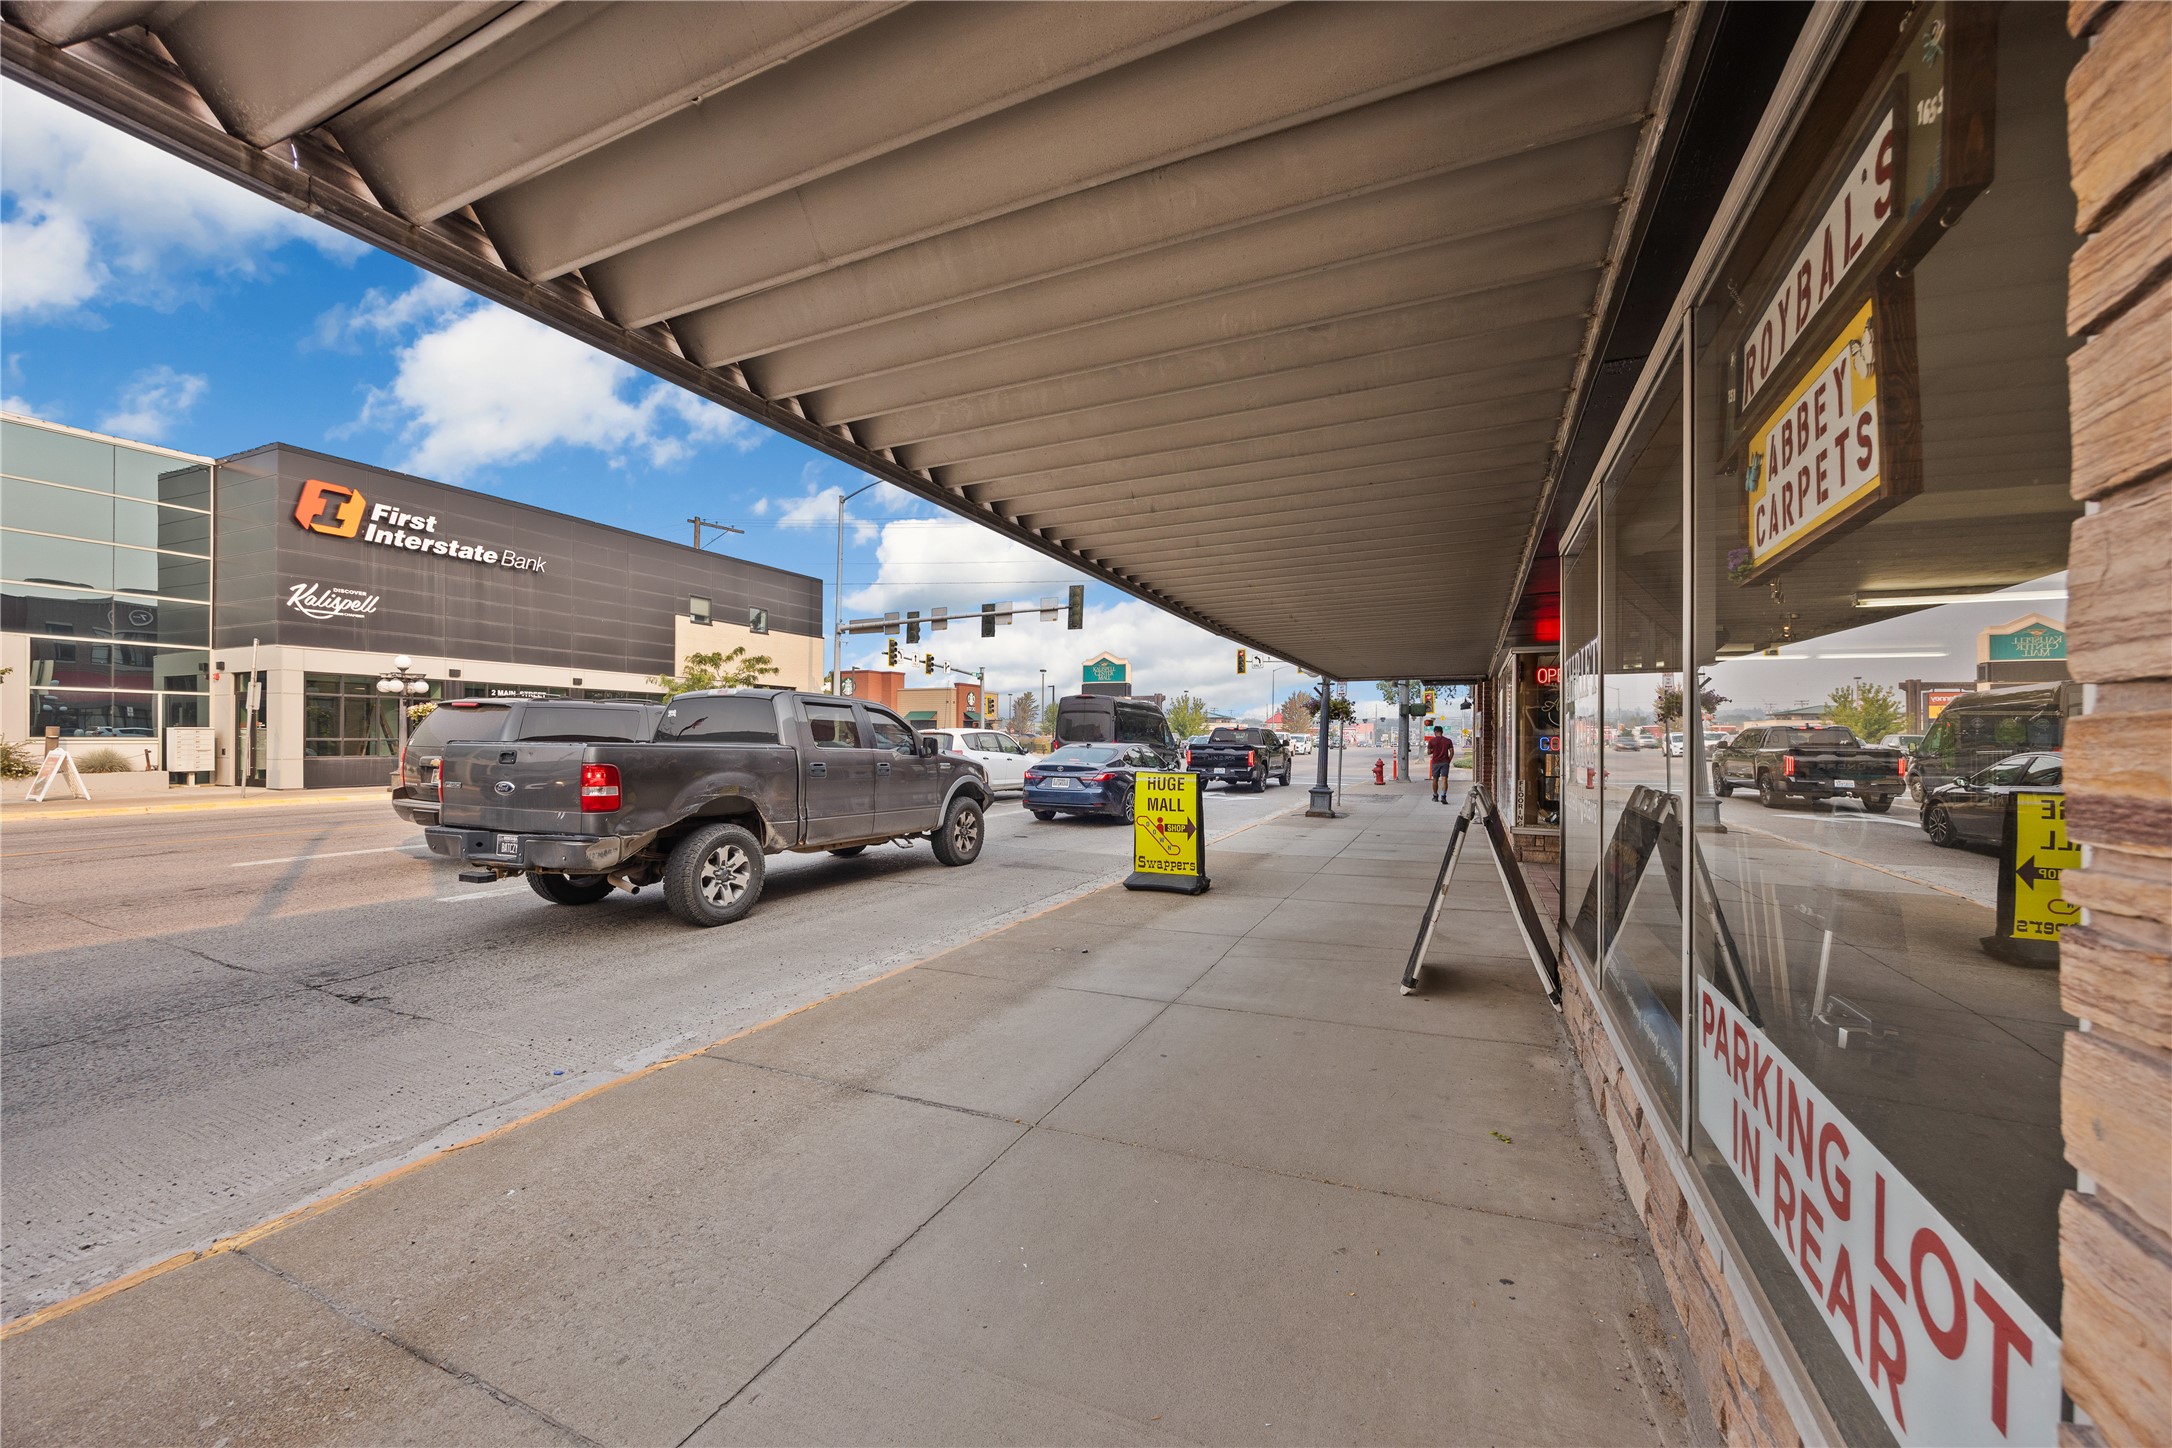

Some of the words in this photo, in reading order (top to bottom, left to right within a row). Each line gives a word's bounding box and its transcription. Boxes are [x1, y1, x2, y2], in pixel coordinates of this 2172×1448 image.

[1744, 128, 1893, 407] ROYBAL'S
[1767, 357, 1847, 482] ABBEY
[1755, 411, 1873, 549] CARPETS
[370, 503, 437, 533] First
[364, 523, 498, 564] Interstate
[500, 549, 547, 573] Bank
[286, 583, 380, 619] Kalispell
[332, 587, 367, 596] DISCOVER
[497, 689, 516, 697] MAIN
[520, 690, 547, 698] STREET
[1147, 776, 1185, 791] HUGE
[1147, 797, 1185, 812] MALL
[1167, 824, 1186, 832] SHOP
[1137, 855, 1196, 872] Swappers
[1702, 989, 1852, 1222] PARKING
[1874, 1171, 2033, 1439] LOT
[1733, 1097, 1760, 1198] IN
[1773, 1152, 1907, 1436] REAR
